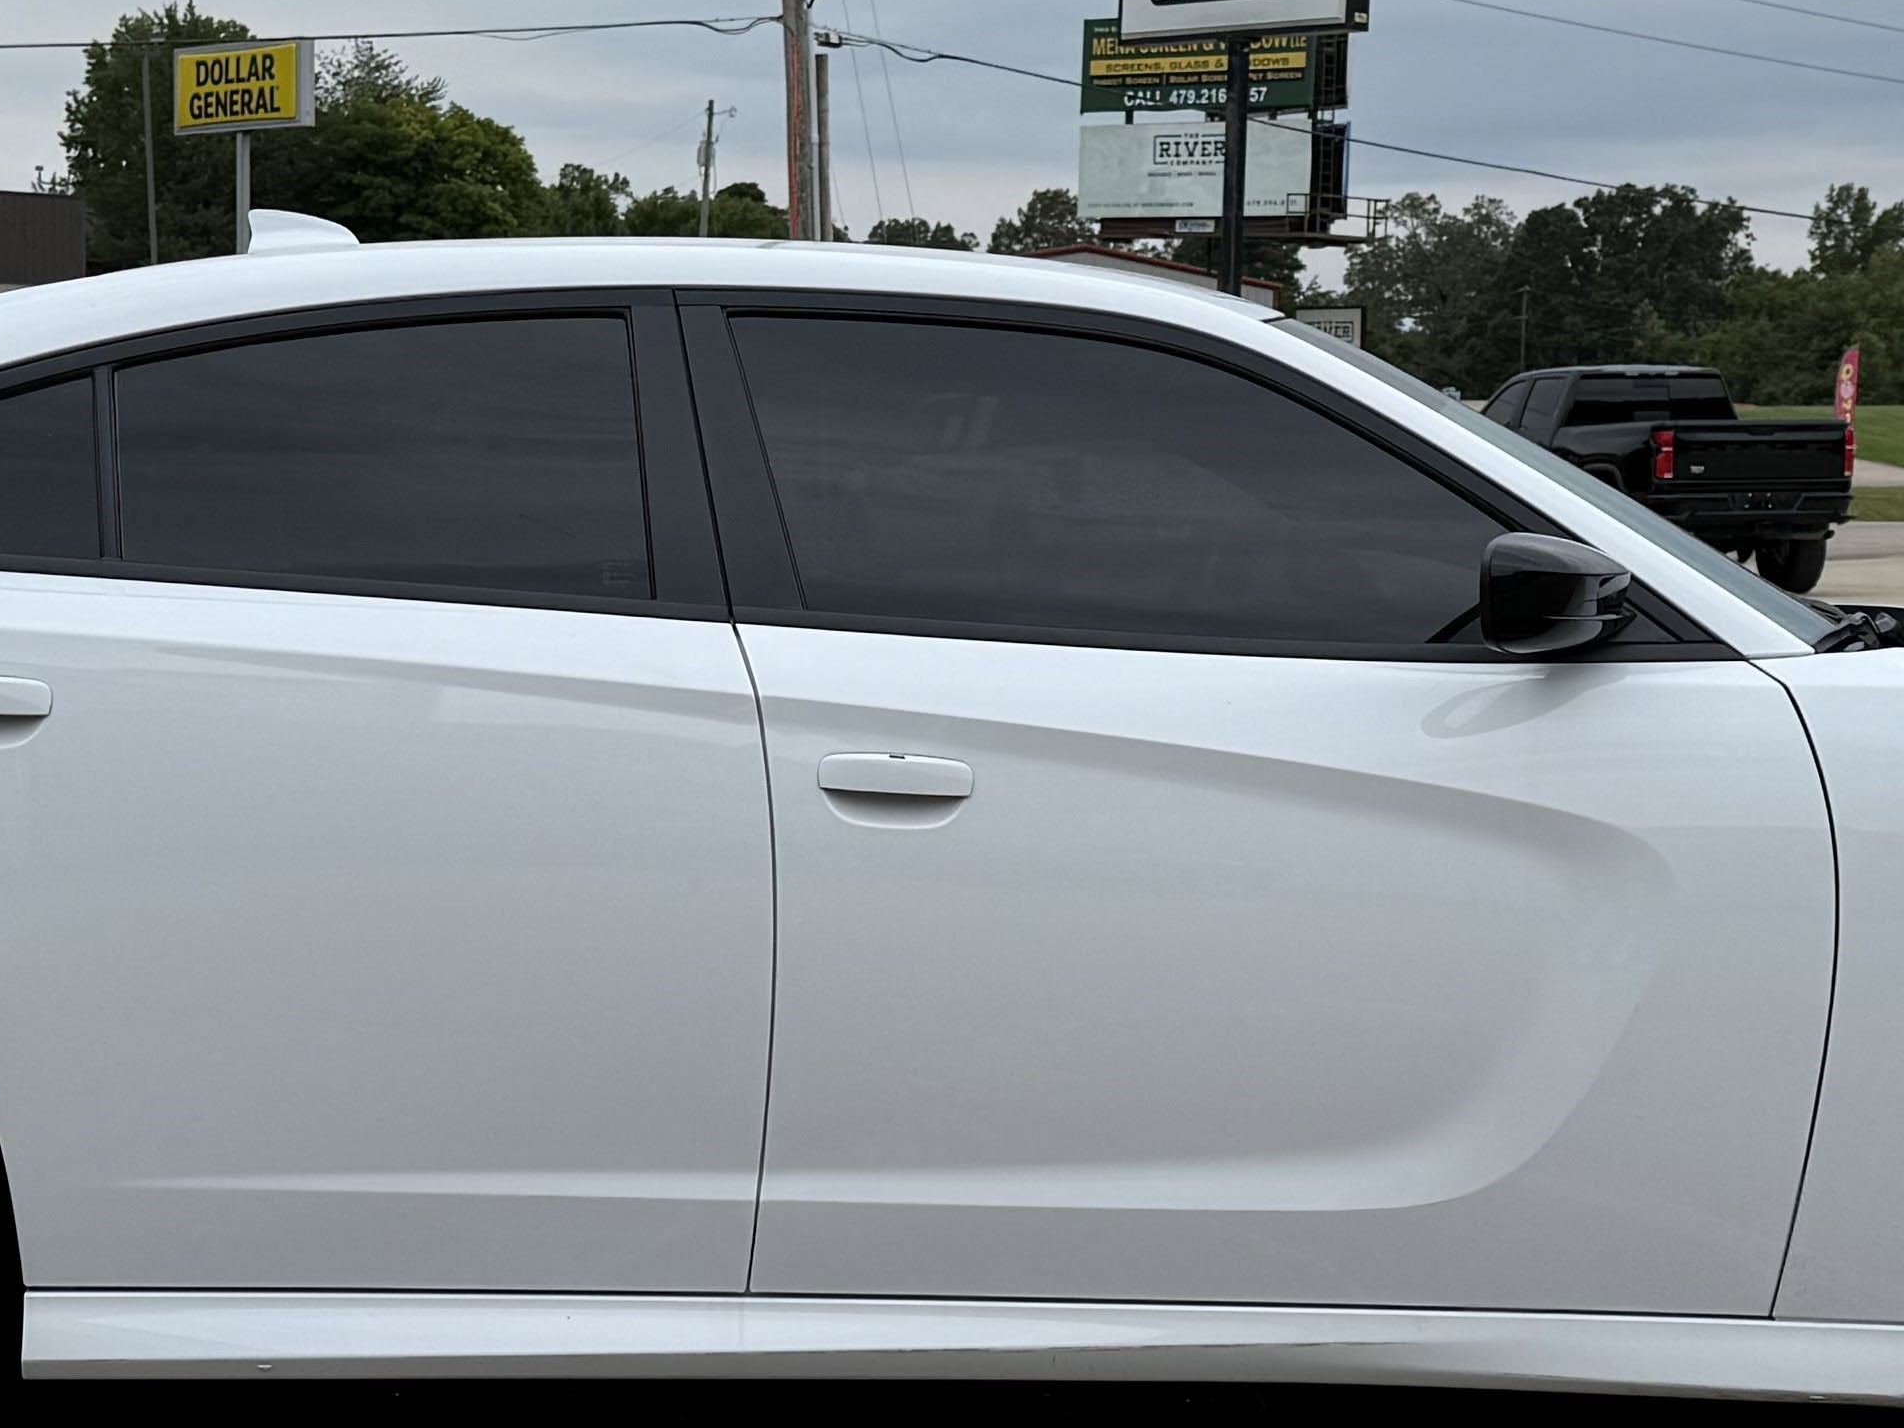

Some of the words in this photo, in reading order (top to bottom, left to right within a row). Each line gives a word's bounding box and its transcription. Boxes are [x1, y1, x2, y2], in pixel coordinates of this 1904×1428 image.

[195, 53, 276, 87] DOLLAR
[1169, 60, 1210, 70] GLASS
[189, 86, 280, 120] GENERAL
[1159, 141, 1226, 158] RIVER
